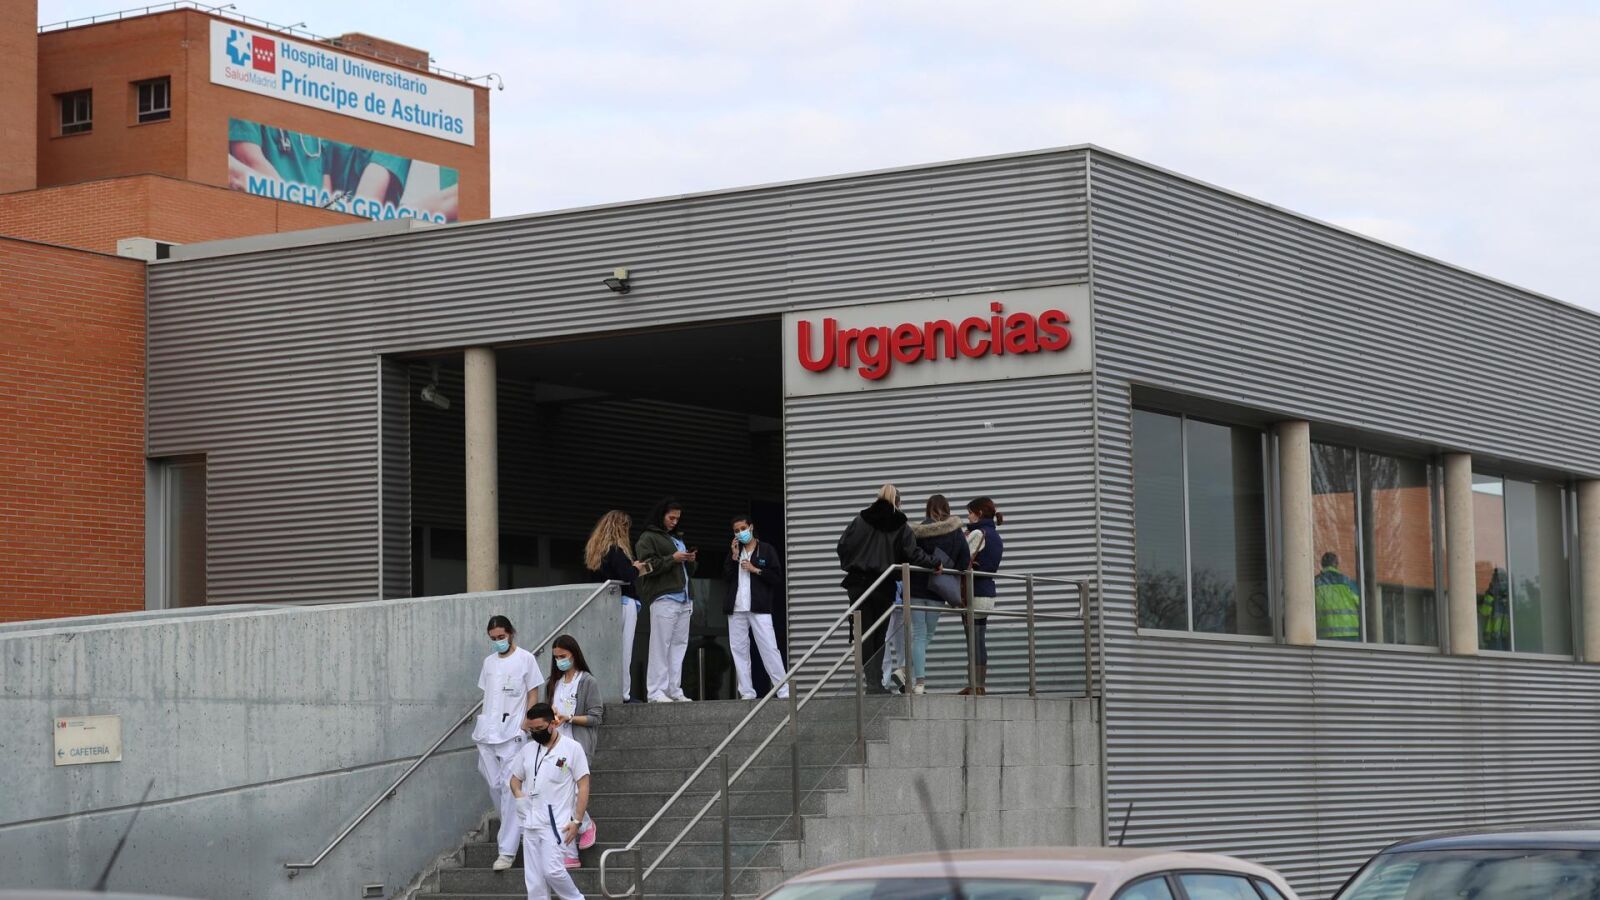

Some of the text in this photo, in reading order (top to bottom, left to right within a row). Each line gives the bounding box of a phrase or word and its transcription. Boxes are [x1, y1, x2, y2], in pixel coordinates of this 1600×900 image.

[281, 42, 428, 95] Hospital Universitario
[281, 69, 464, 134] Príncipe de Asturias
[797, 302, 1072, 379] Urgencias
[69, 745, 110, 757] CAFETERÍA
